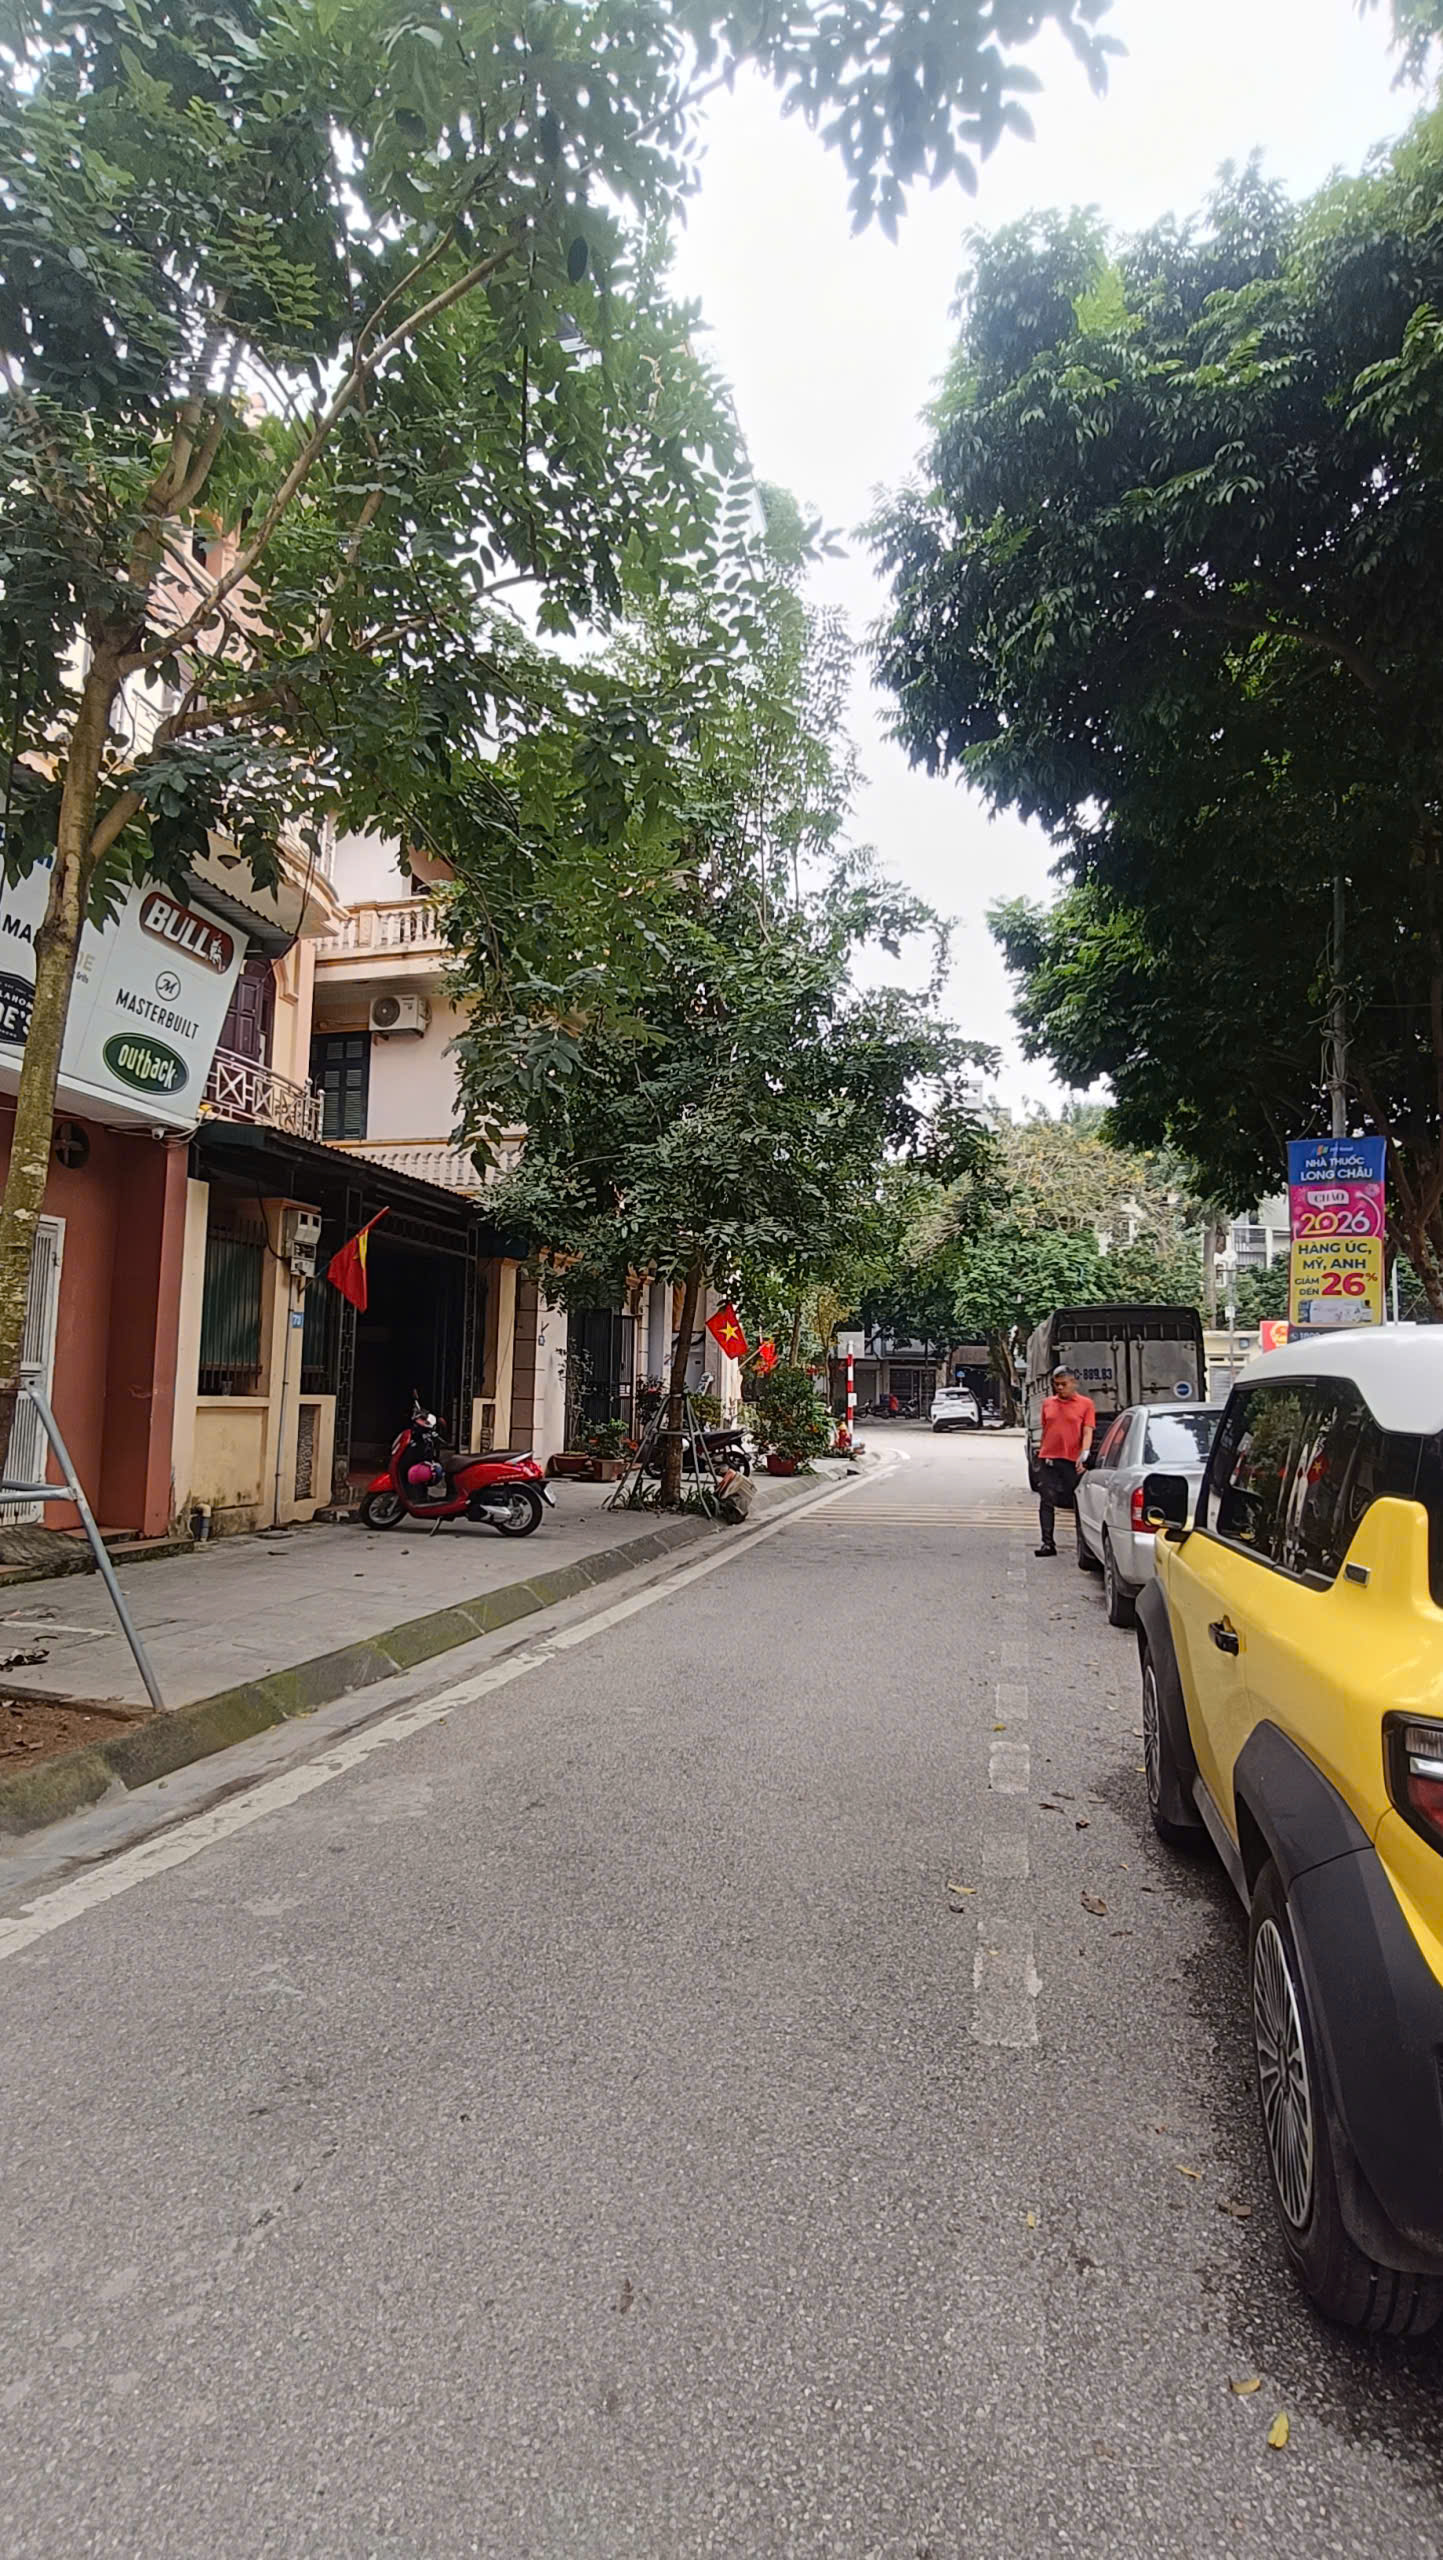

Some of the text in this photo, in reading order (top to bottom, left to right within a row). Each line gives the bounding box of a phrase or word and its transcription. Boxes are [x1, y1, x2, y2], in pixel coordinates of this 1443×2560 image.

[144, 898, 210, 958] BULL
[115, 988, 200, 1040] MASTERBUILT
[118, 1043, 177, 1089] outback
[1305, 1154, 1365, 1168] NHÀ THUỐC
[1300, 1166, 1373, 1181] LONG CHÂU
[1300, 1211, 1370, 1235] 2026
[1298, 1240, 1372, 1254] HÀNG ÚC,
[1330, 1259, 1366, 1269] ANH
